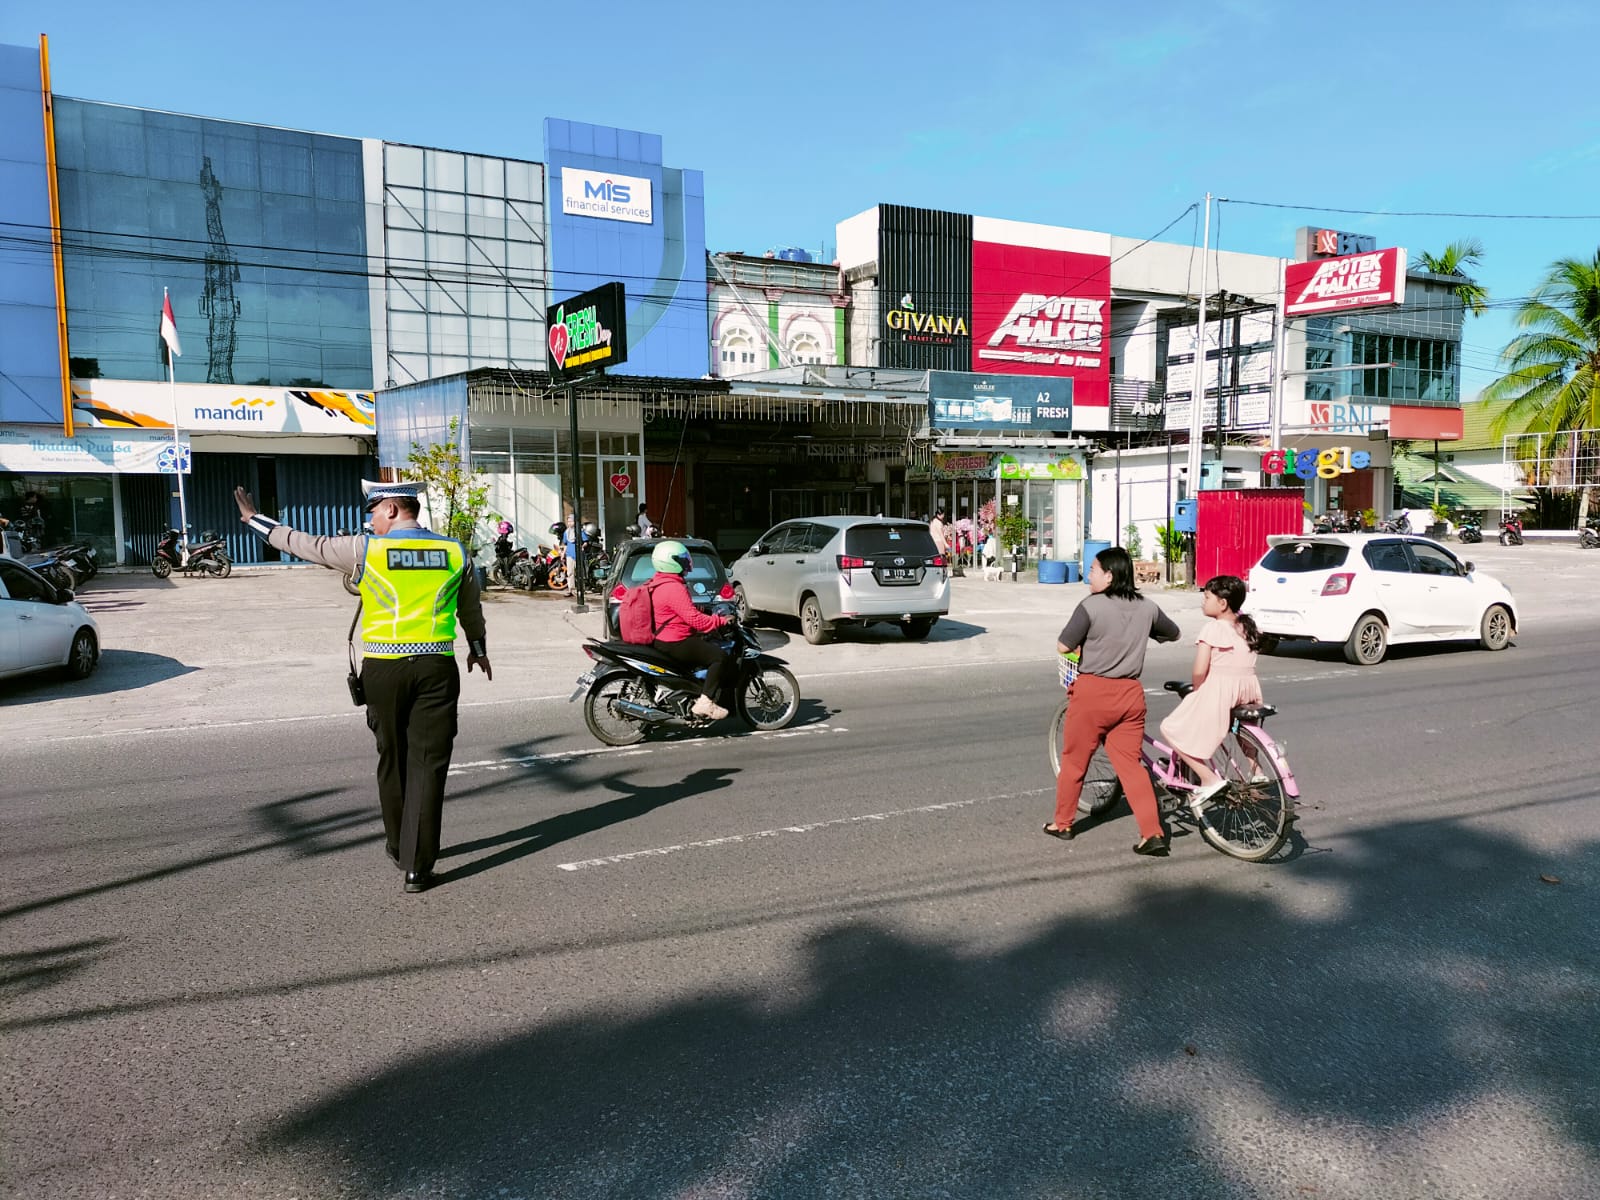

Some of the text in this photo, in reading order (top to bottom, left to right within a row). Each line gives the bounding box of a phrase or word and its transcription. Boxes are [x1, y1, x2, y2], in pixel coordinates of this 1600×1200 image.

[566, 196, 650, 218] financial services
[1310, 252, 1385, 280] APOTEK
[1004, 292, 1106, 323] APOTEK
[566, 305, 597, 353] FRESH
[887, 310, 969, 336] GIVANA
[1036, 392, 1050, 403] A2
[194, 404, 263, 421] mandiri
[1036, 407, 1069, 419] FRESH
[1333, 404, 1373, 433] BNI
[957, 456, 986, 469] FRESH
[1261, 446, 1371, 479] Giggle
[388, 550, 446, 568] POLISI
